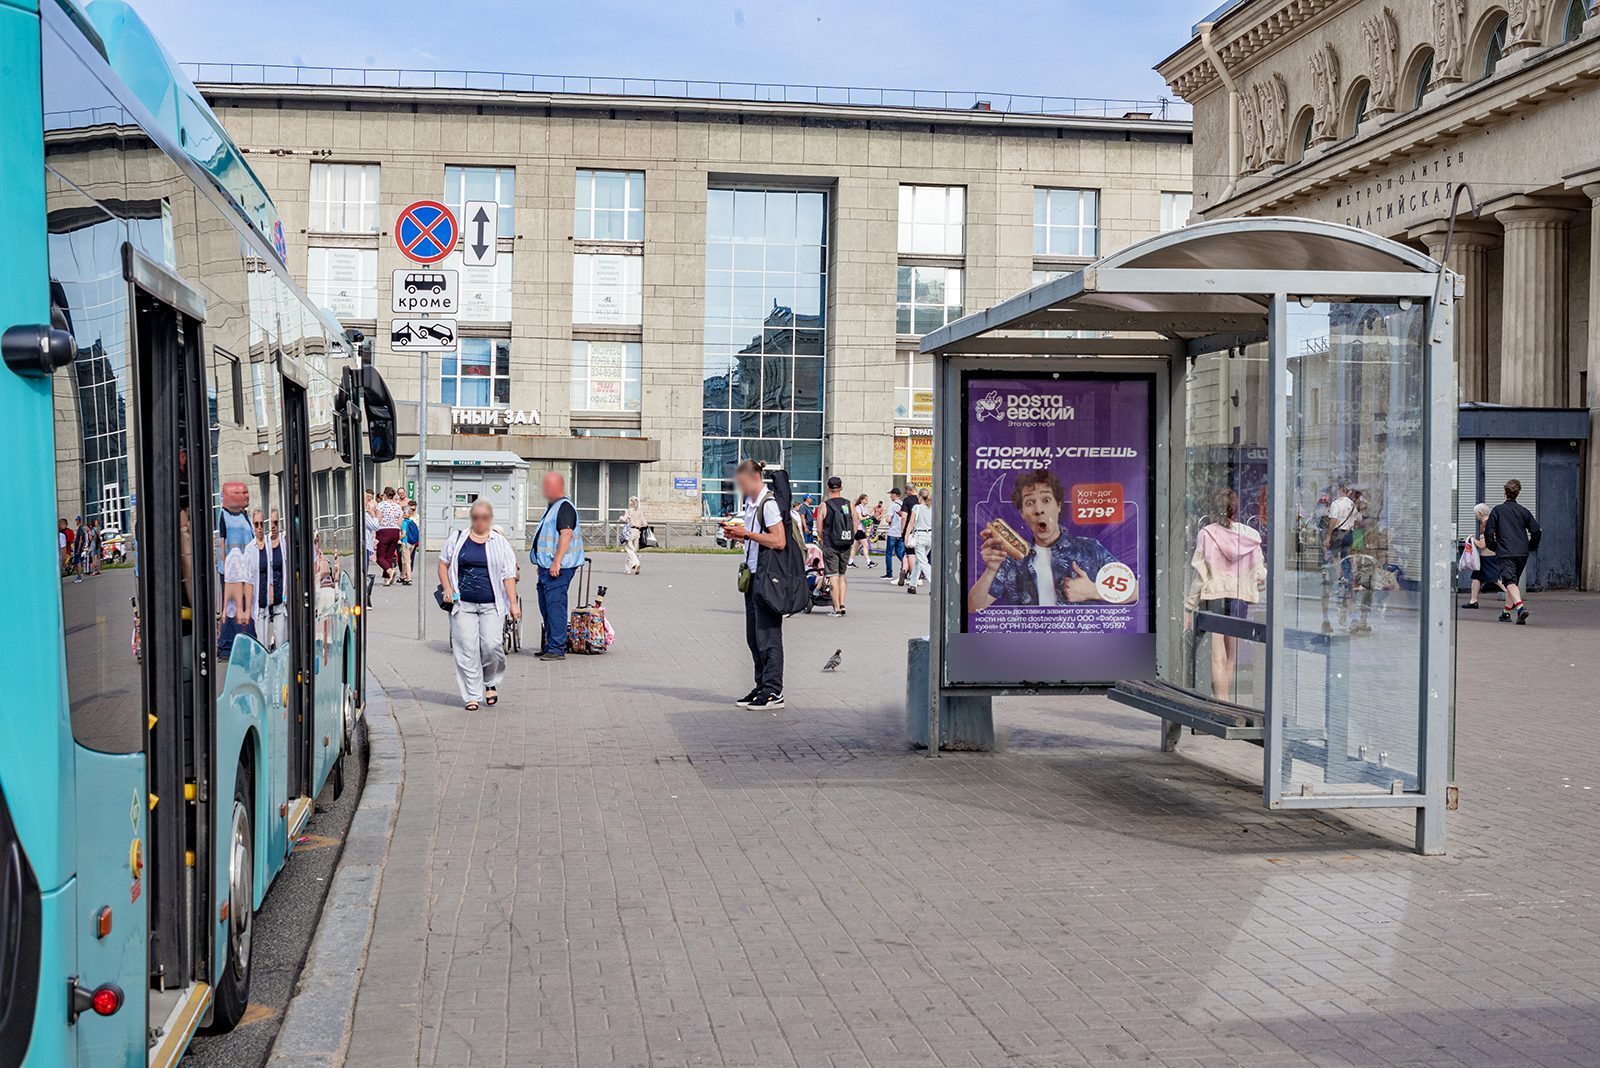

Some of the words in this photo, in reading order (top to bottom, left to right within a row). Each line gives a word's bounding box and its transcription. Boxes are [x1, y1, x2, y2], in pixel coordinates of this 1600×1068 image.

[1336, 151, 1464, 208] МЕТРОПОЛИТЕН
[1345, 181, 1452, 228] БАЛТИЙСКАЯ
[398, 298, 451, 310] кроме
[504, 409, 541, 425] ЗАЛ
[976, 446, 1054, 461] СПОРИМ,
[1056, 446, 1138, 458] УСПЕЕШЬ
[976, 458, 1052, 470] ПОЕСТЬ?
[1078, 490, 1112, 498] Хот-дог
[1078, 506, 1115, 518] 279₽
[1102, 575, 1128, 592] 45
[1028, 615, 1076, 624] dostaevsky.ru
